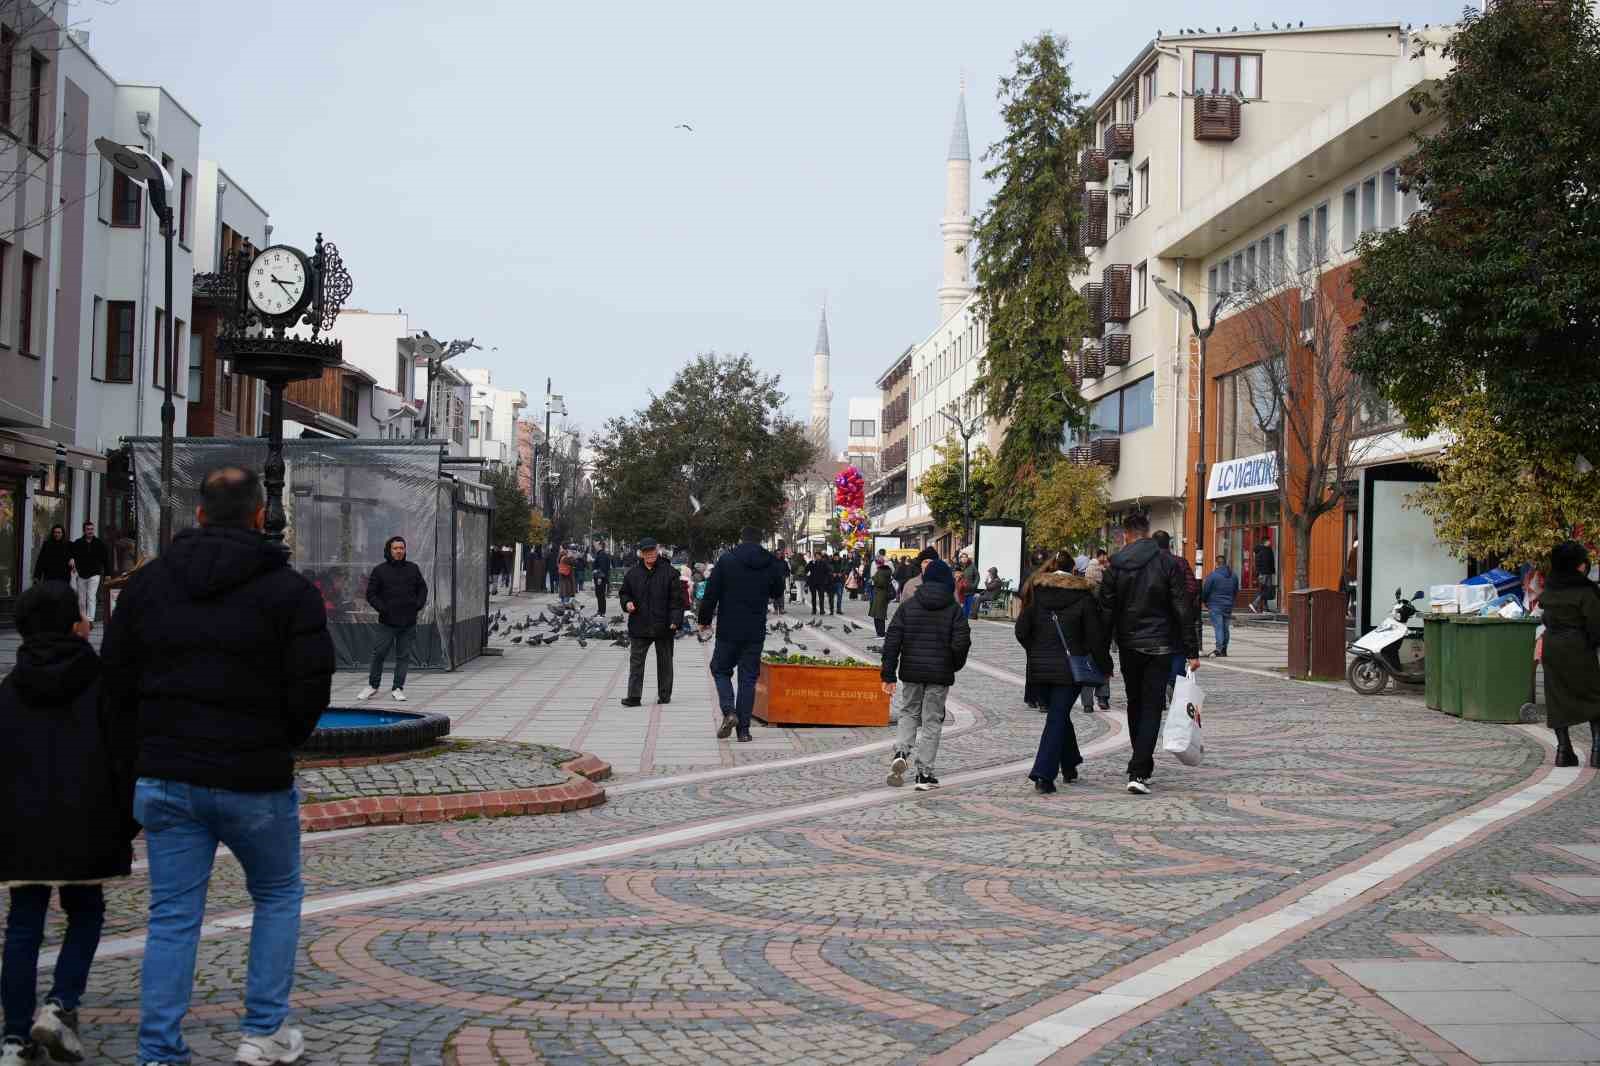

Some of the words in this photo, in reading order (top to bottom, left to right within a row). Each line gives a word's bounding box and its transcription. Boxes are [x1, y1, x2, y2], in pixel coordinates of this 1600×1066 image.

[274, 254, 280, 262] 12
[276, 302, 282, 310] 6
[1217, 464, 1233, 491] LC
